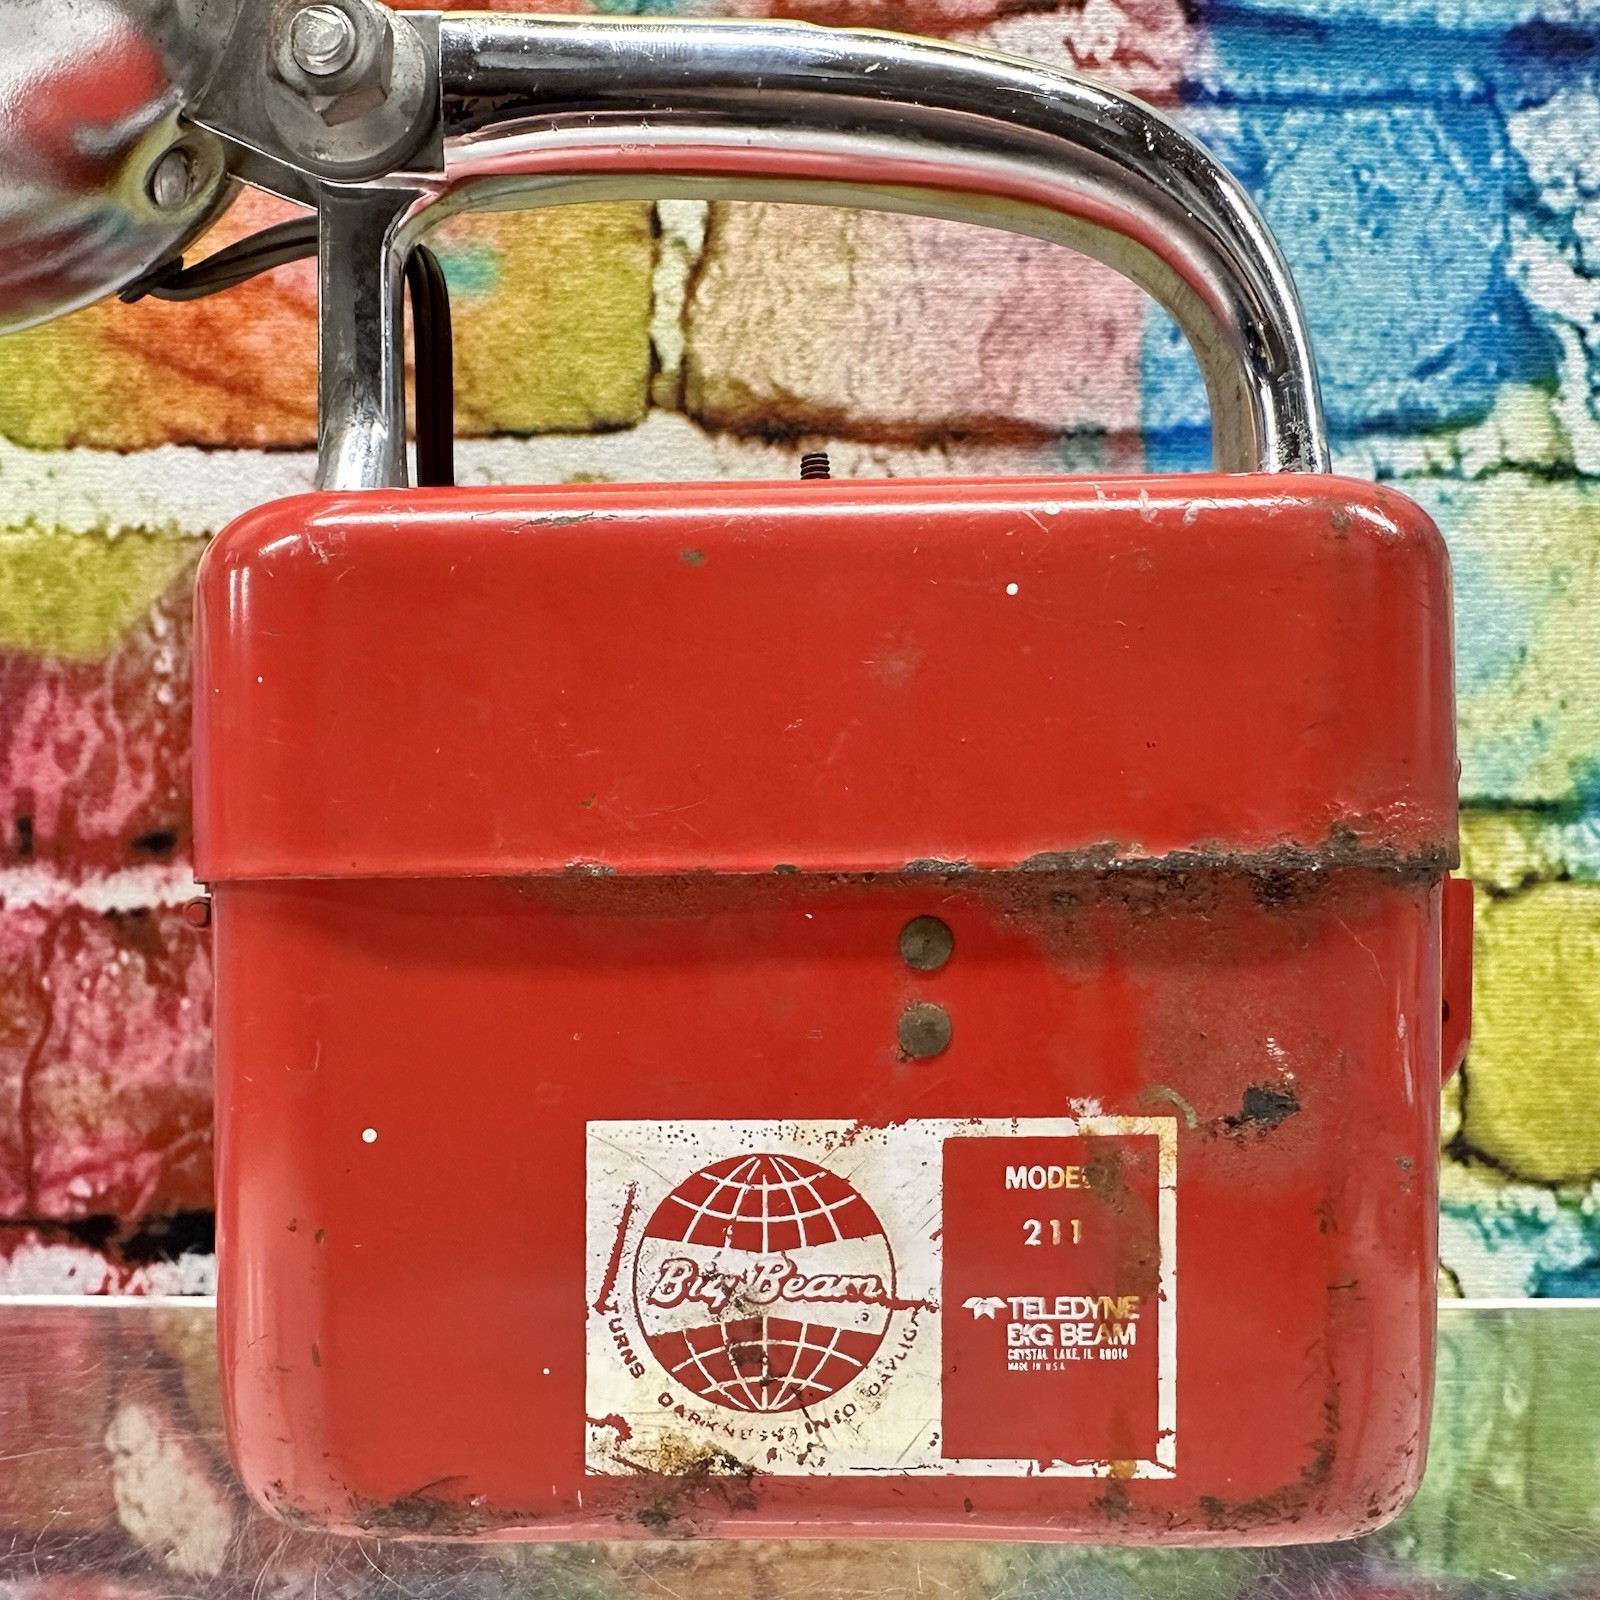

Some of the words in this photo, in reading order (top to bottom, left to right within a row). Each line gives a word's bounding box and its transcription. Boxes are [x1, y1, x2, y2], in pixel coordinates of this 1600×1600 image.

[1022, 1218, 1082, 1245] 211
[648, 1257, 738, 1314] Big
[747, 1257, 884, 1304] Beam
[1006, 1295, 1140, 1319] TELEDYNE
[599, 1300, 645, 1378] TURNS
[1007, 1322, 1053, 1346] BIG
[1059, 1322, 1137, 1345] BEAM
[1007, 1348, 1049, 1360] CRYSTAL
[1032, 1362, 1042, 1371] IN
